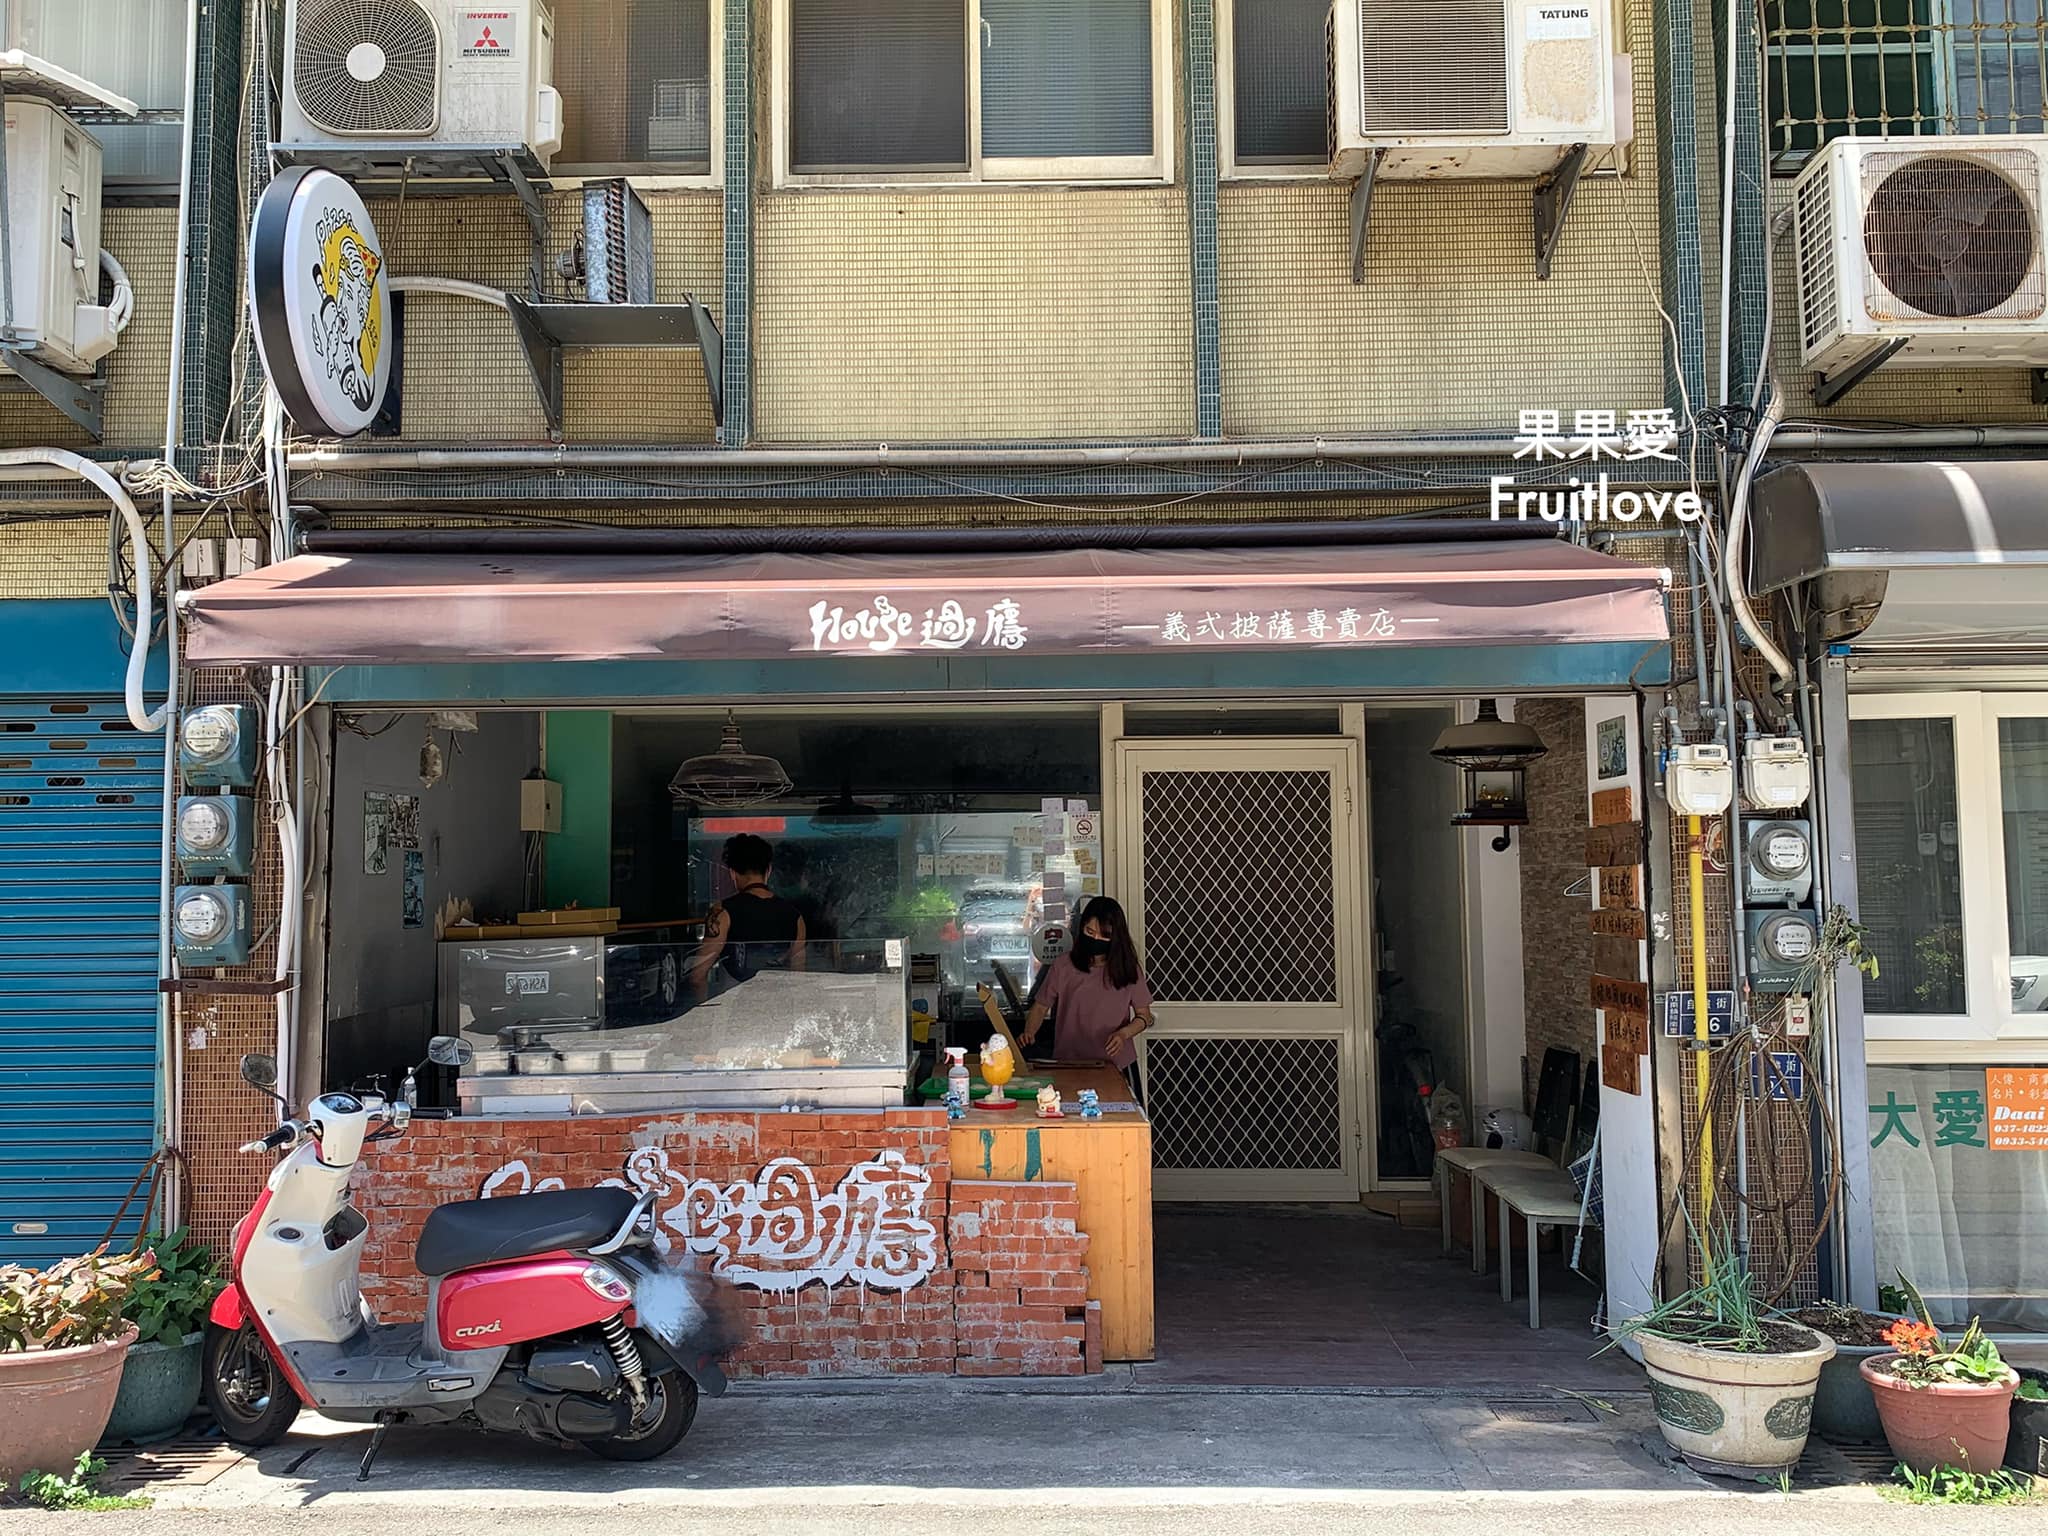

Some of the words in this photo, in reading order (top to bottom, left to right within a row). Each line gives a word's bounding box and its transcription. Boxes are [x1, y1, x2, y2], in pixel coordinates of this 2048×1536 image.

[1539, 9, 1589, 19] TATUNG
[809, 595, 913, 651] House
[1161, 607, 1397, 642] 義式披薩專賣店
[1869, 1090, 1985, 1149] 大愛
[1994, 1106, 2045, 1120] Daai
